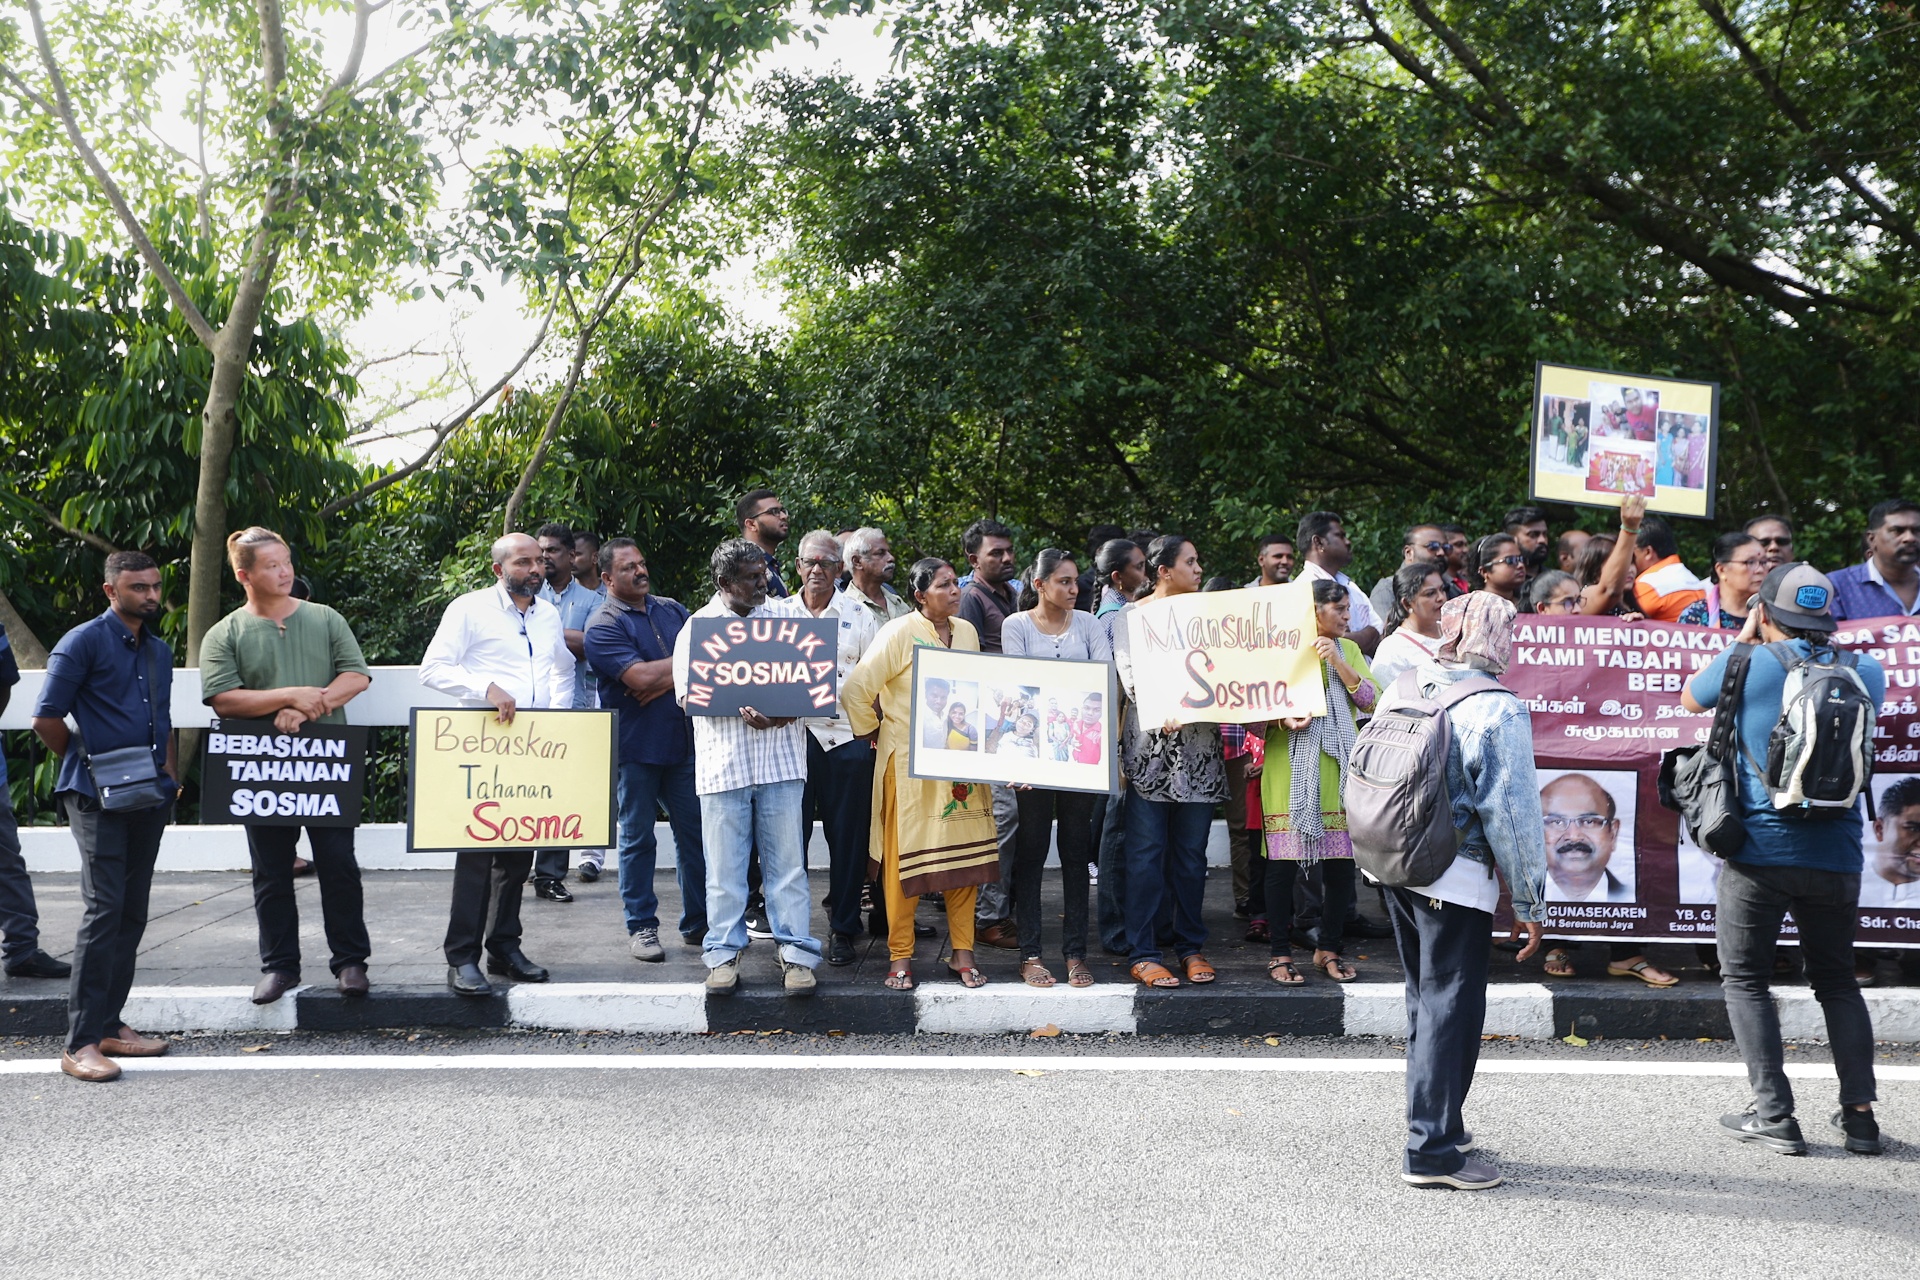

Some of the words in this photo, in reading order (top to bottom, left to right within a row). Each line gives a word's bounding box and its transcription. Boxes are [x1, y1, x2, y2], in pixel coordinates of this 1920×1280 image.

[1142, 602, 1300, 652] Mansuhkan
[688, 620, 836, 709] MANSUHKAN
[1518, 646, 1584, 666] KAMI
[1594, 649, 1682, 670] TABAH
[1691, 653, 1717, 670] M
[714, 660, 812, 686] SOSMA
[1180, 649, 1294, 710] Sosma
[1884, 668, 1920, 688] TU
[1519, 694, 1586, 714] ங்கள்
[208, 733, 346, 758] BEBASKAN
[434, 716, 568, 760] Bebaskan
[227, 760, 351, 782] TAHANAN
[458, 764, 552, 800] Tahanan
[229, 788, 340, 816] SOSMA
[466, 801, 583, 842] Sosma
[1548, 906, 1647, 918] GUNASEKAREN
[1676, 909, 1698, 921] YB.
[1860, 916, 1891, 928] Sdr.
[1558, 919, 1608, 929] Seremban
[1610, 920, 1634, 931] Jaya
[1670, 922, 1694, 932] Exco
